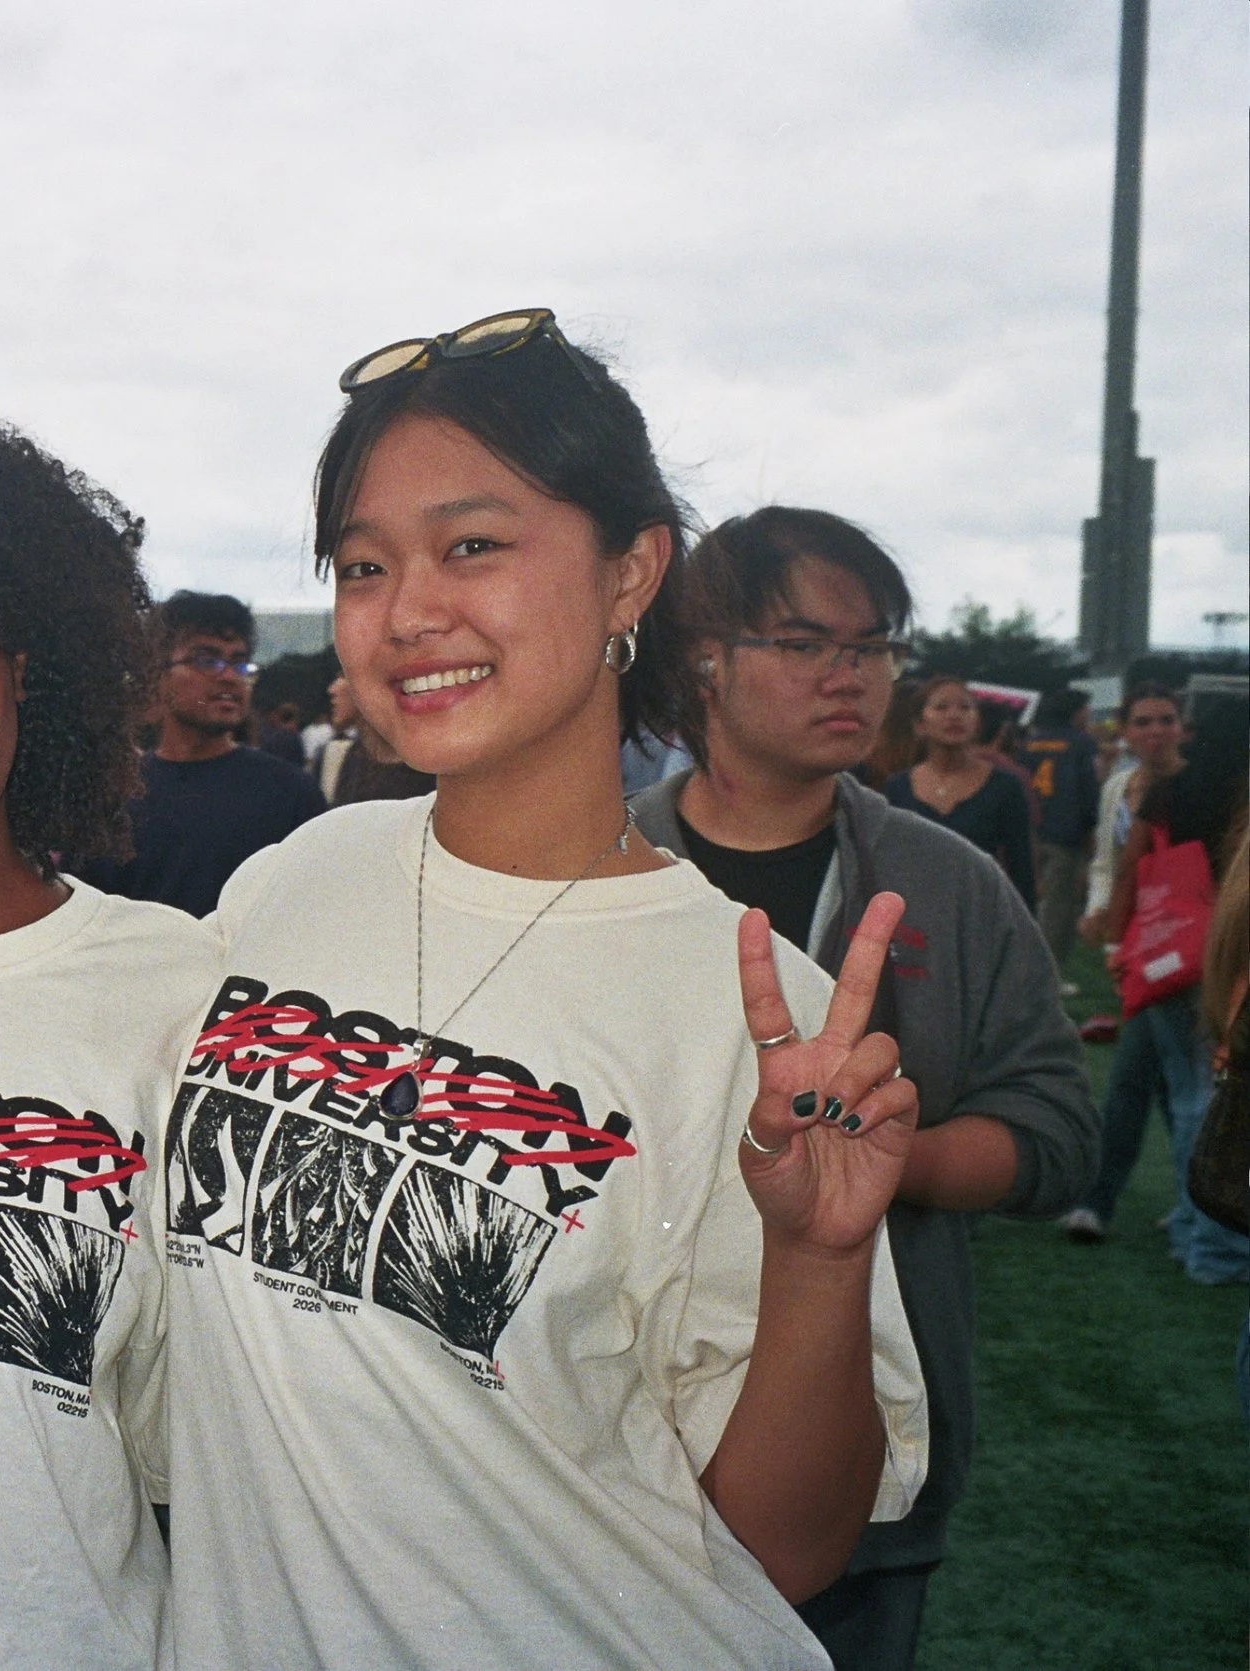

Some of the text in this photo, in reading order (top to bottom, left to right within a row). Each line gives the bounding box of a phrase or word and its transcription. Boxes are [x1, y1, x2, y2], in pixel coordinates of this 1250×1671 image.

[253, 1271, 297, 1294] STUDENT
[293, 1298, 322, 1313] 2026
[32, 1379, 75, 1403] BOSTON,
[57, 1401, 89, 1418] 02215
